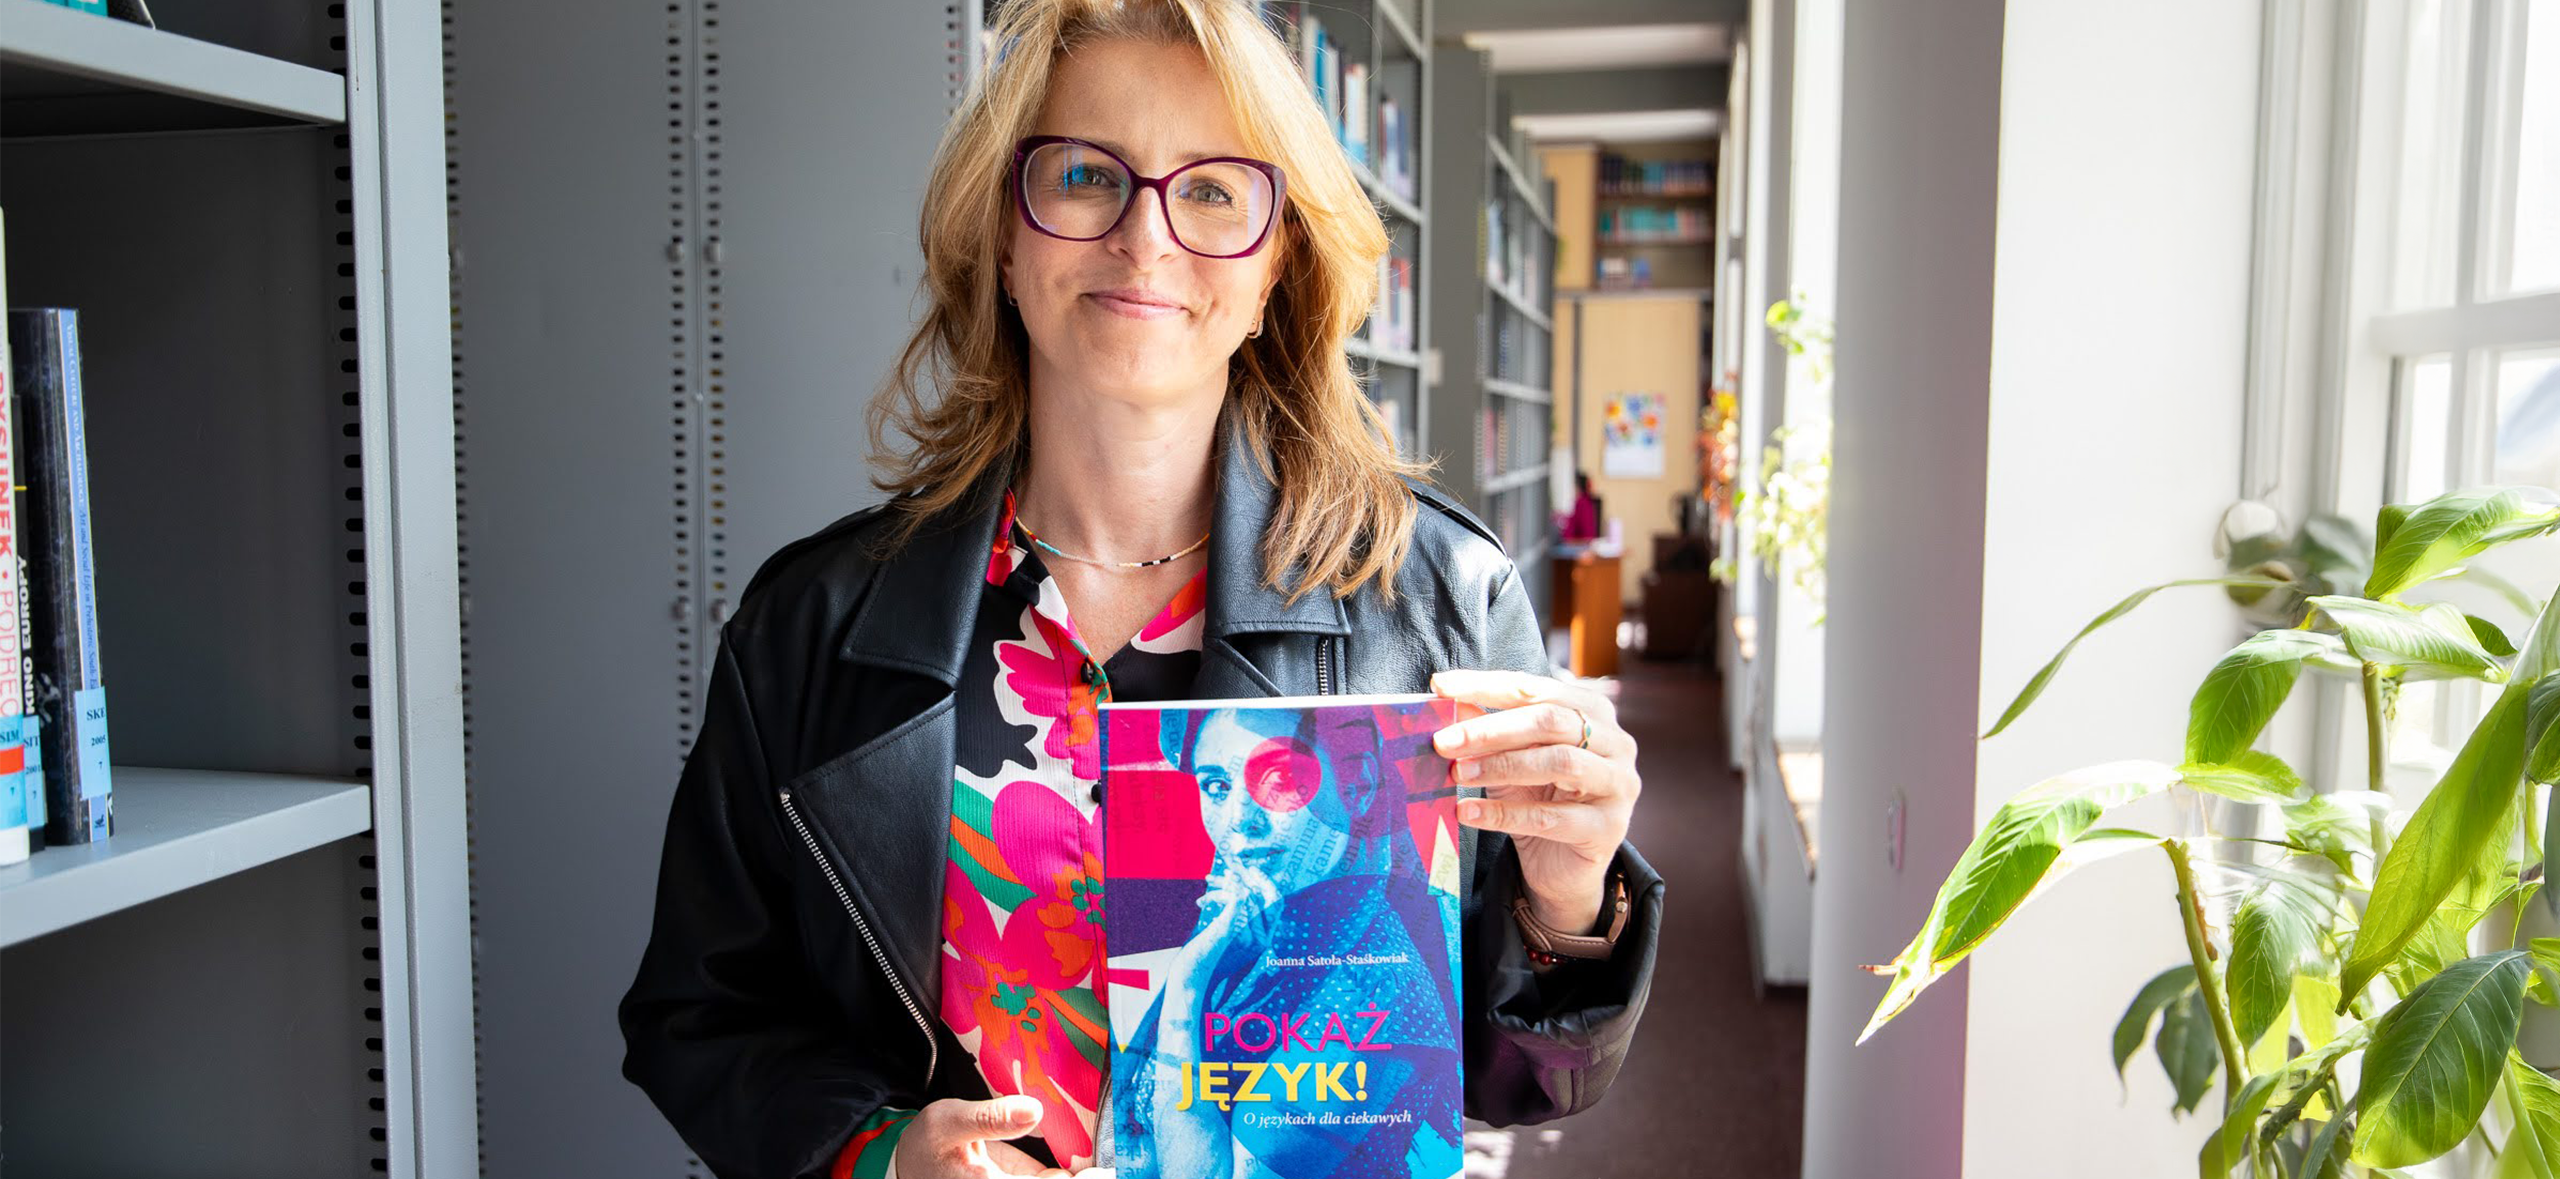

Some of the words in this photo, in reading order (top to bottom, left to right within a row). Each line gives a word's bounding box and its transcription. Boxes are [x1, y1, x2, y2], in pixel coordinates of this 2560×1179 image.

[17, 554, 32, 651] EUROPY
[23, 656, 36, 716] KINO
[23, 735, 40, 749] SIT
[91, 734, 107, 747] 2005
[1265, 956, 1306, 968] Joanna
[1307, 951, 1410, 967] Satoła-Staśkowiak
[1204, 1001, 1393, 1053] POKAŻ
[1175, 1060, 1369, 1112] JĘZYK!
[1243, 1111, 1257, 1126] O
[1257, 1111, 1316, 1129] językach
[1319, 1111, 1341, 1125] dla
[1343, 1109, 1413, 1129] ciekawych
